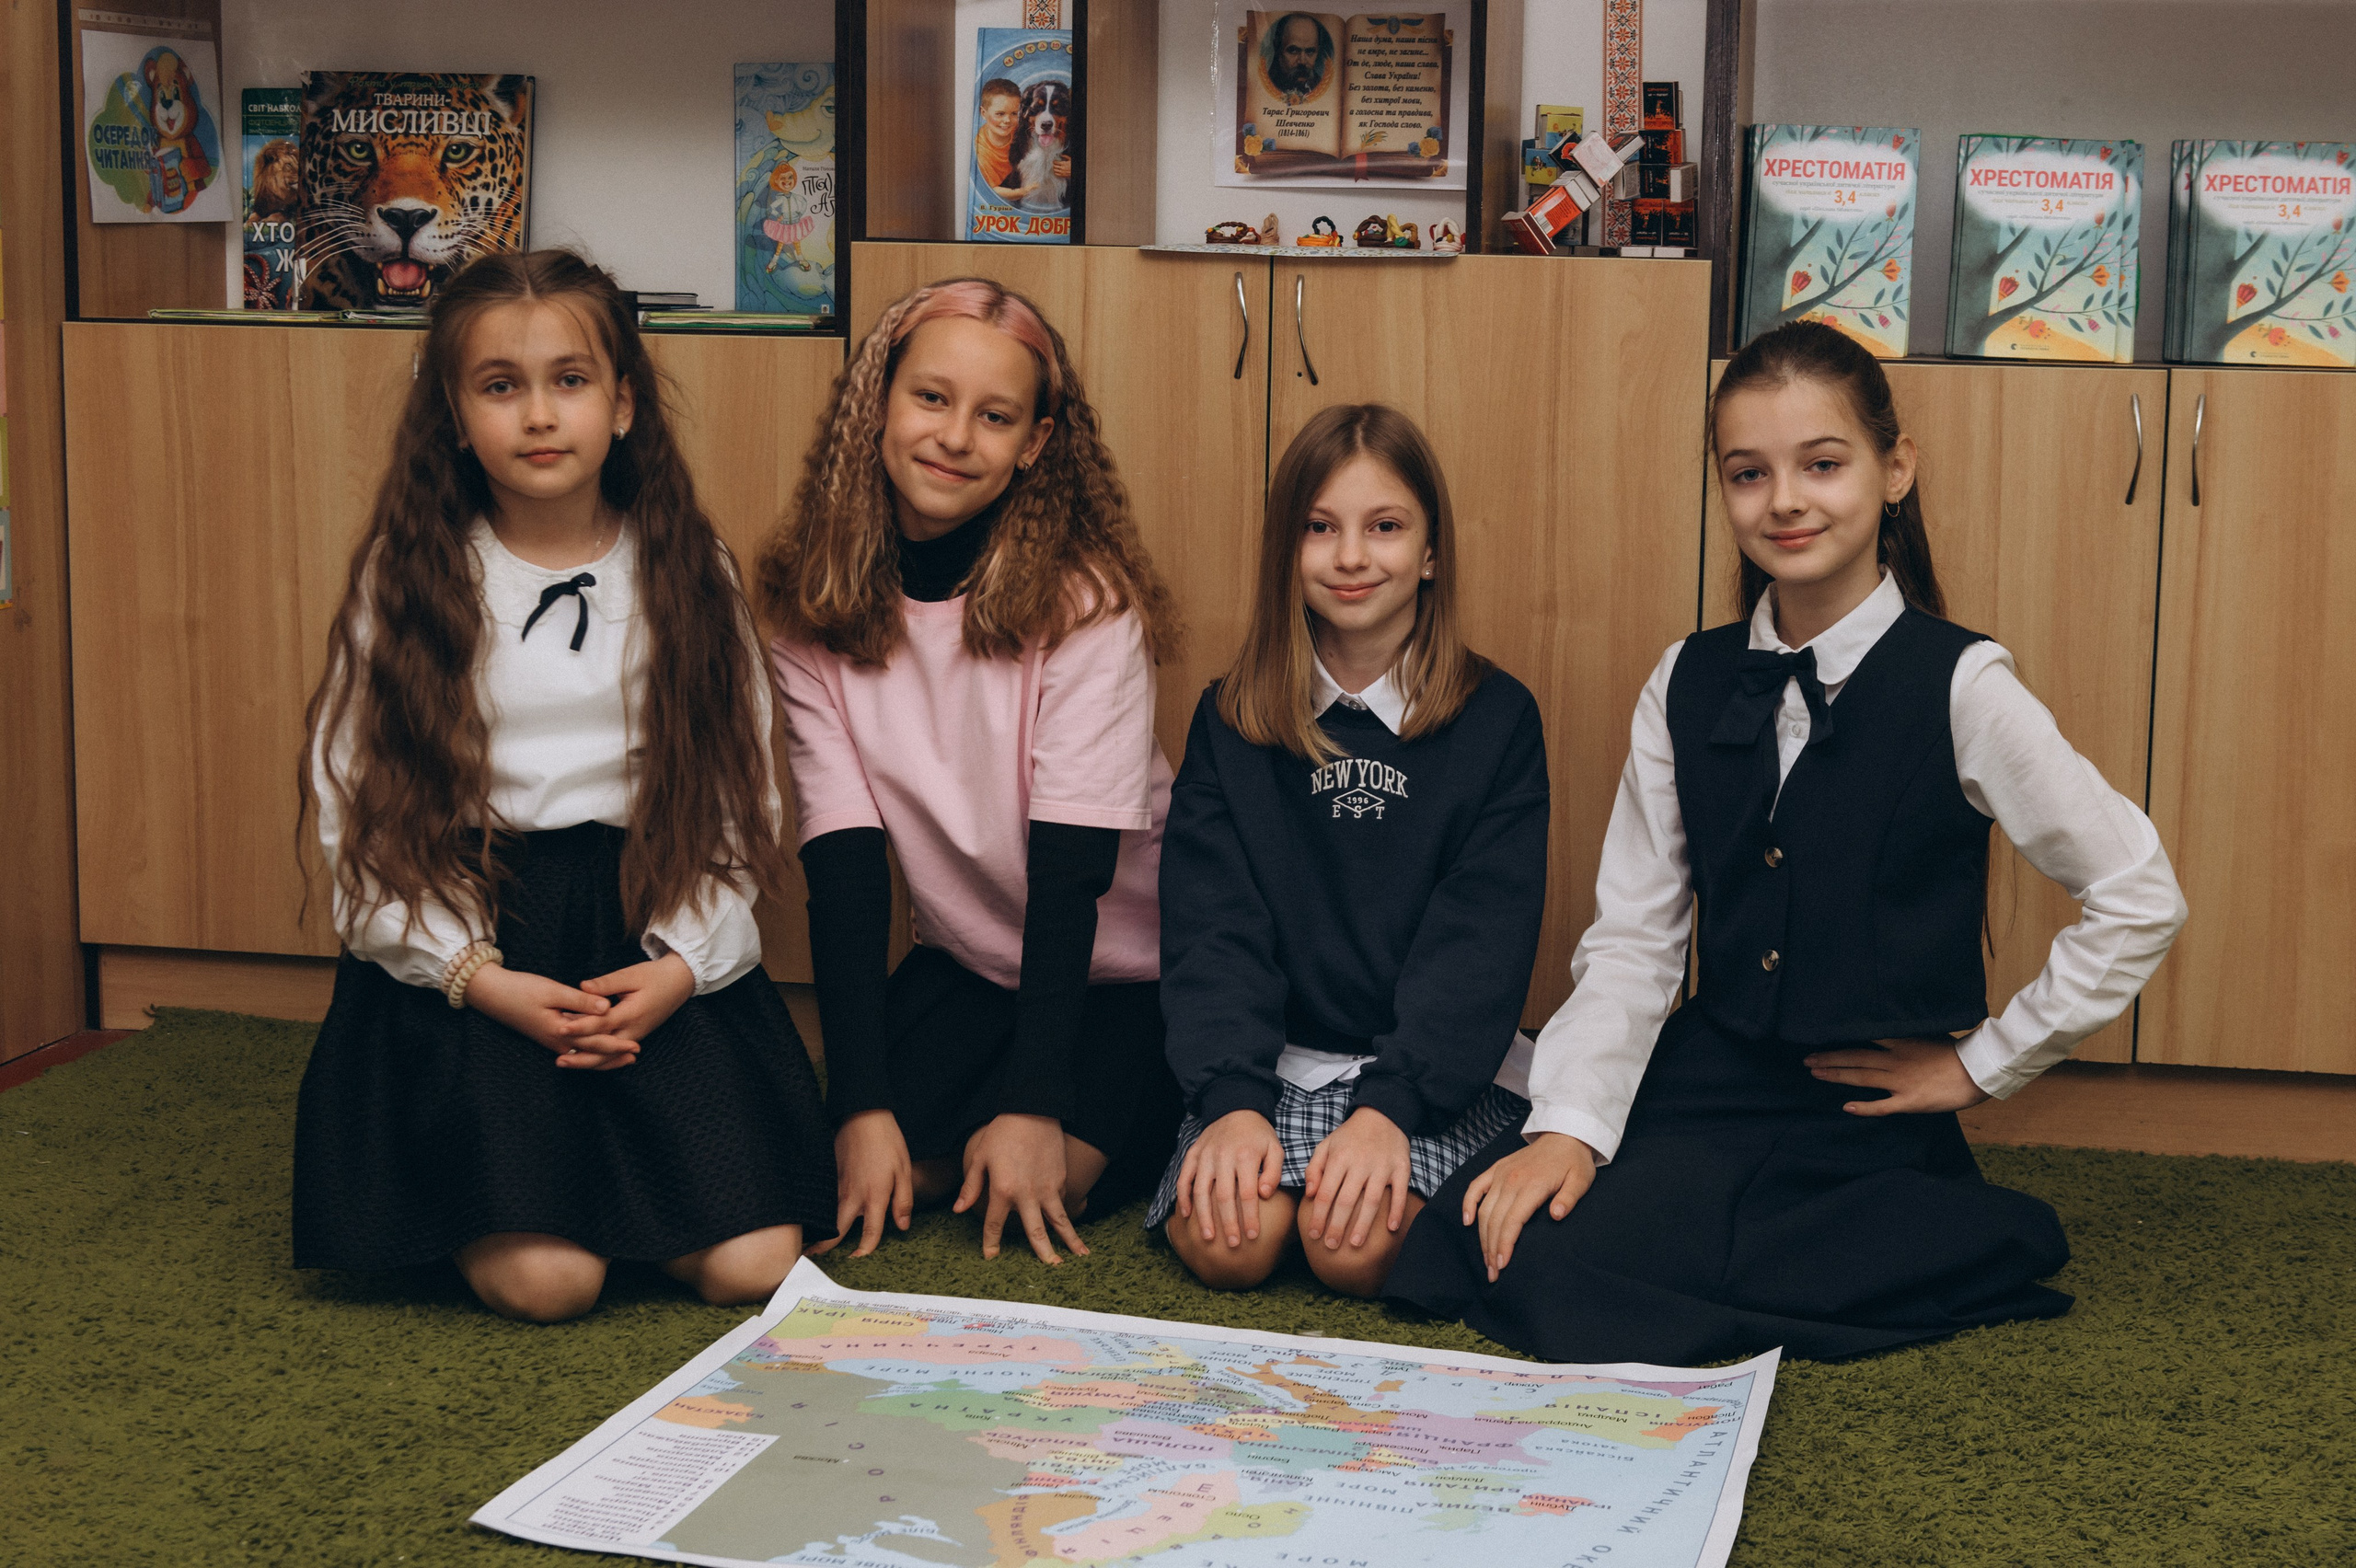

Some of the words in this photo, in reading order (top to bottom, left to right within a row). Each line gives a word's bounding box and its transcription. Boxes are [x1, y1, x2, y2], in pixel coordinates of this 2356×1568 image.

[1350, 35, 1372, 43] Наша
[1364, 71, 1386, 79] Слава
[1388, 72, 1421, 81] України!
[1348, 83, 1361, 91] Без
[374, 93, 451, 107] ТВАРИНИ-
[1262, 107, 1284, 118] Тарас
[1285, 108, 1330, 118] Григорович
[331, 109, 492, 139] МИСЛИВЦІ
[1275, 119, 1315, 128] Шевченко
[1369, 120, 1399, 128] Господа
[94, 123, 159, 148] ОСЕРЕДОК
[1277, 129, 1311, 138] (1814-1861)
[95, 148, 151, 169] ЧИТАННЯ
[1764, 158, 1906, 180] ХРЕСТОМАТІЯ
[1969, 168, 2114, 190] ХРЕСТОМАТІЯ
[2204, 174, 2351, 195] ХРЕСТОМАТІЯ
[973, 215, 1022, 234] УРОК
[252, 222, 295, 243] ХТО
[1311, 758, 1354, 795] NEW
[1355, 758, 1409, 799] YORK
[1346, 796, 1369, 804] 1996
[796, 1308, 847, 1317] ІРАК
[861, 1317, 914, 1326] СИРІЯ
[1697, 1381, 1734, 1389] Рабат
[1311, 1391, 1362, 1400] Ватикан
[1303, 1399, 1381, 1408] Сан-Марино
[674, 1403, 766, 1419] КАЗАХСТАН
[1544, 1403, 1662, 1418] ІСПАНІЯ
[1687, 1411, 1737, 1419] Лісабон
[1576, 1412, 1629, 1423] Мадрид
[1649, 1417, 1742, 1426] ПОРТУГАЛІЯ
[1112, 1436, 1214, 1450] ПОЛЬЩА
[1396, 1432, 1513, 1447] ФРАНЦІЯ
[1560, 1439, 1619, 1449] затока
[1438, 1445, 1482, 1453] Париж
[1534, 1446, 1634, 1460] Біскайська
[1250, 1476, 1313, 1486] ДАНІЯ
[1403, 1480, 1521, 1493] БРИТАНІЯ
[1616, 1432, 1729, 1534] АТЛАНТИЧНИЙ
[1334, 1482, 1397, 1494] МОРЕ
[1303, 1495, 1415, 1513] ПІВНІЧНЕ
[1415, 1502, 1511, 1513] ВЕЛИКА
[1520, 1495, 1613, 1509] ІРЛАНДІЯ
[1530, 1502, 1578, 1511] Дублін
